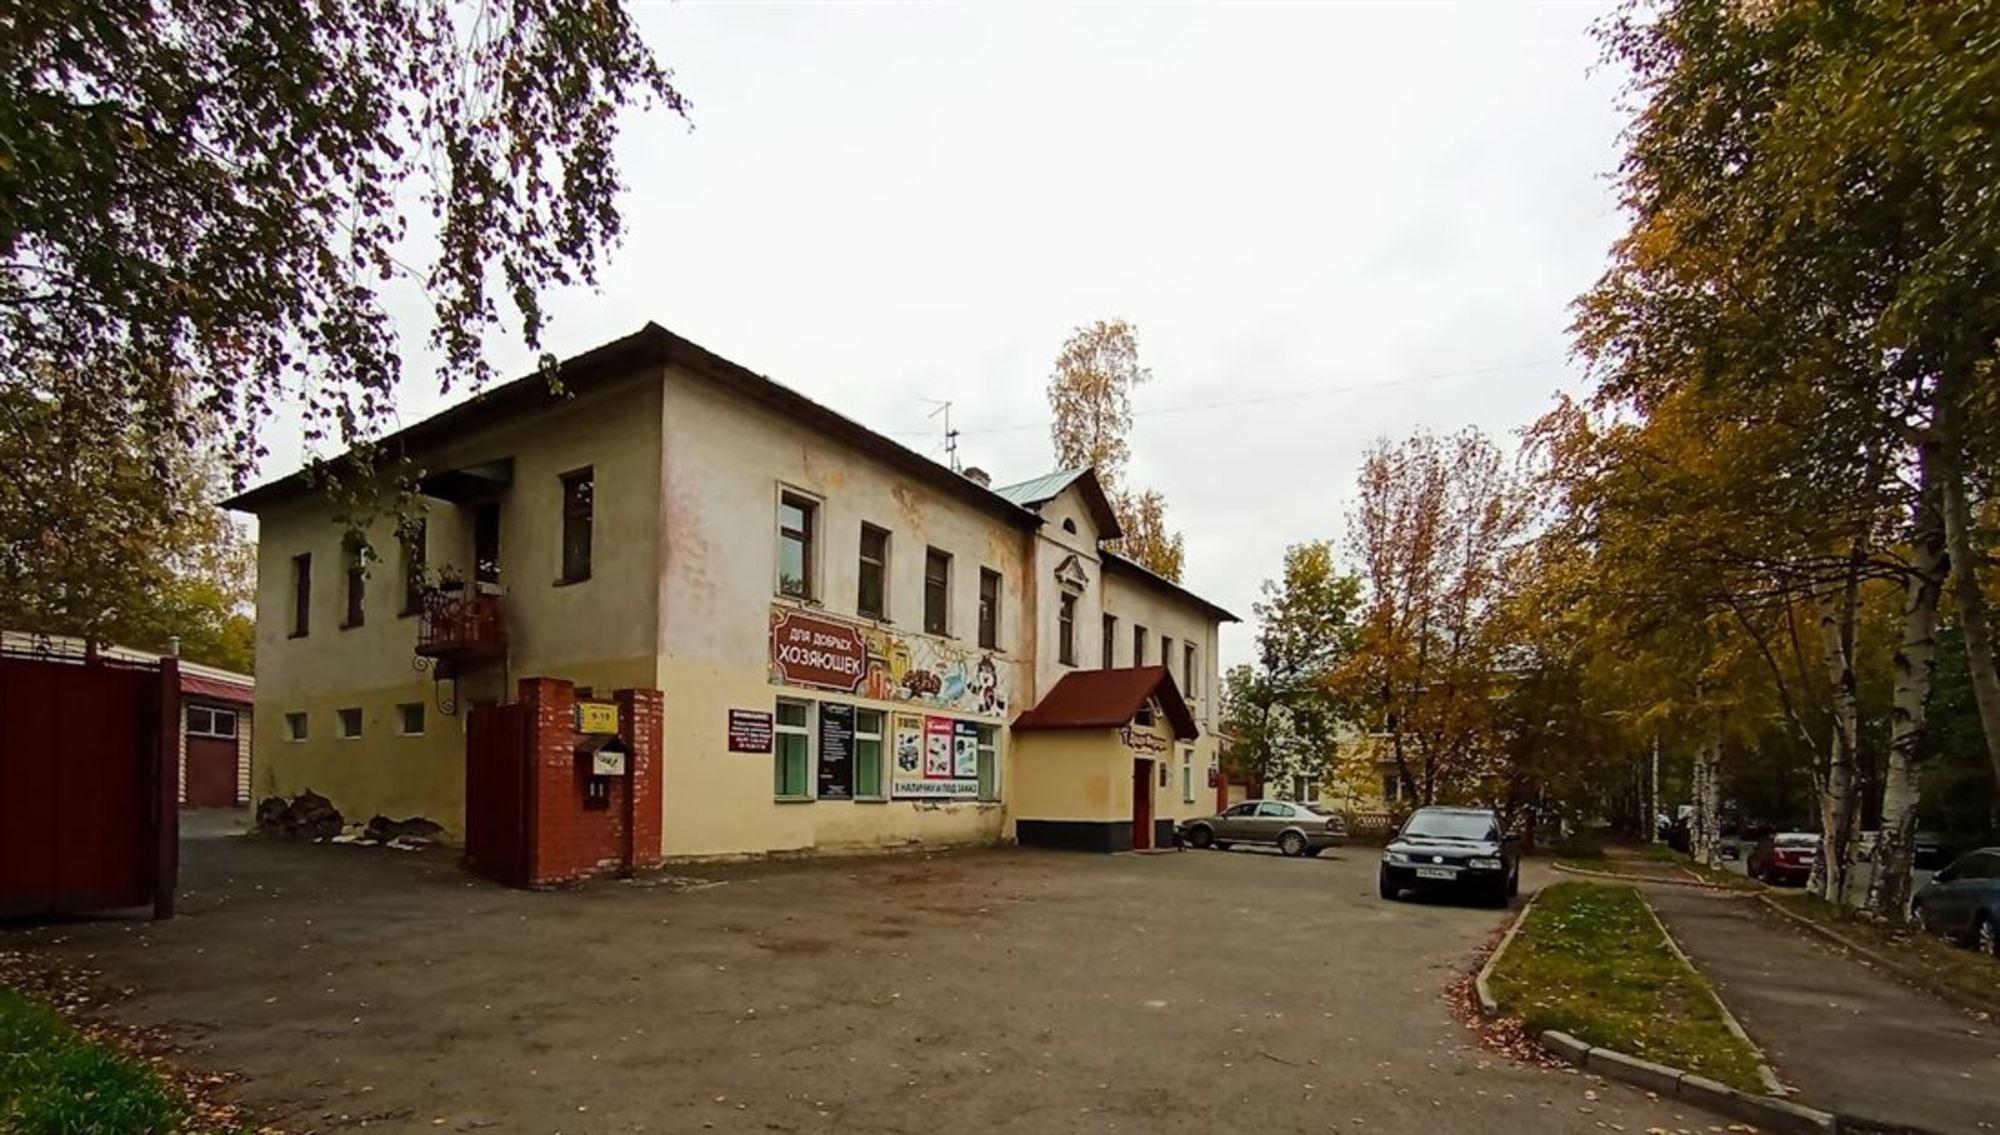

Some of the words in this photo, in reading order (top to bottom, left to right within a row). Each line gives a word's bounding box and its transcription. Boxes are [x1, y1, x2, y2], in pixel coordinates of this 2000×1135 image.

[790, 627, 811, 643] ДЛЯ
[813, 632, 853, 652] ДОБРЫХ
[779, 643, 862, 676] ХОЗЯЮШЕК
